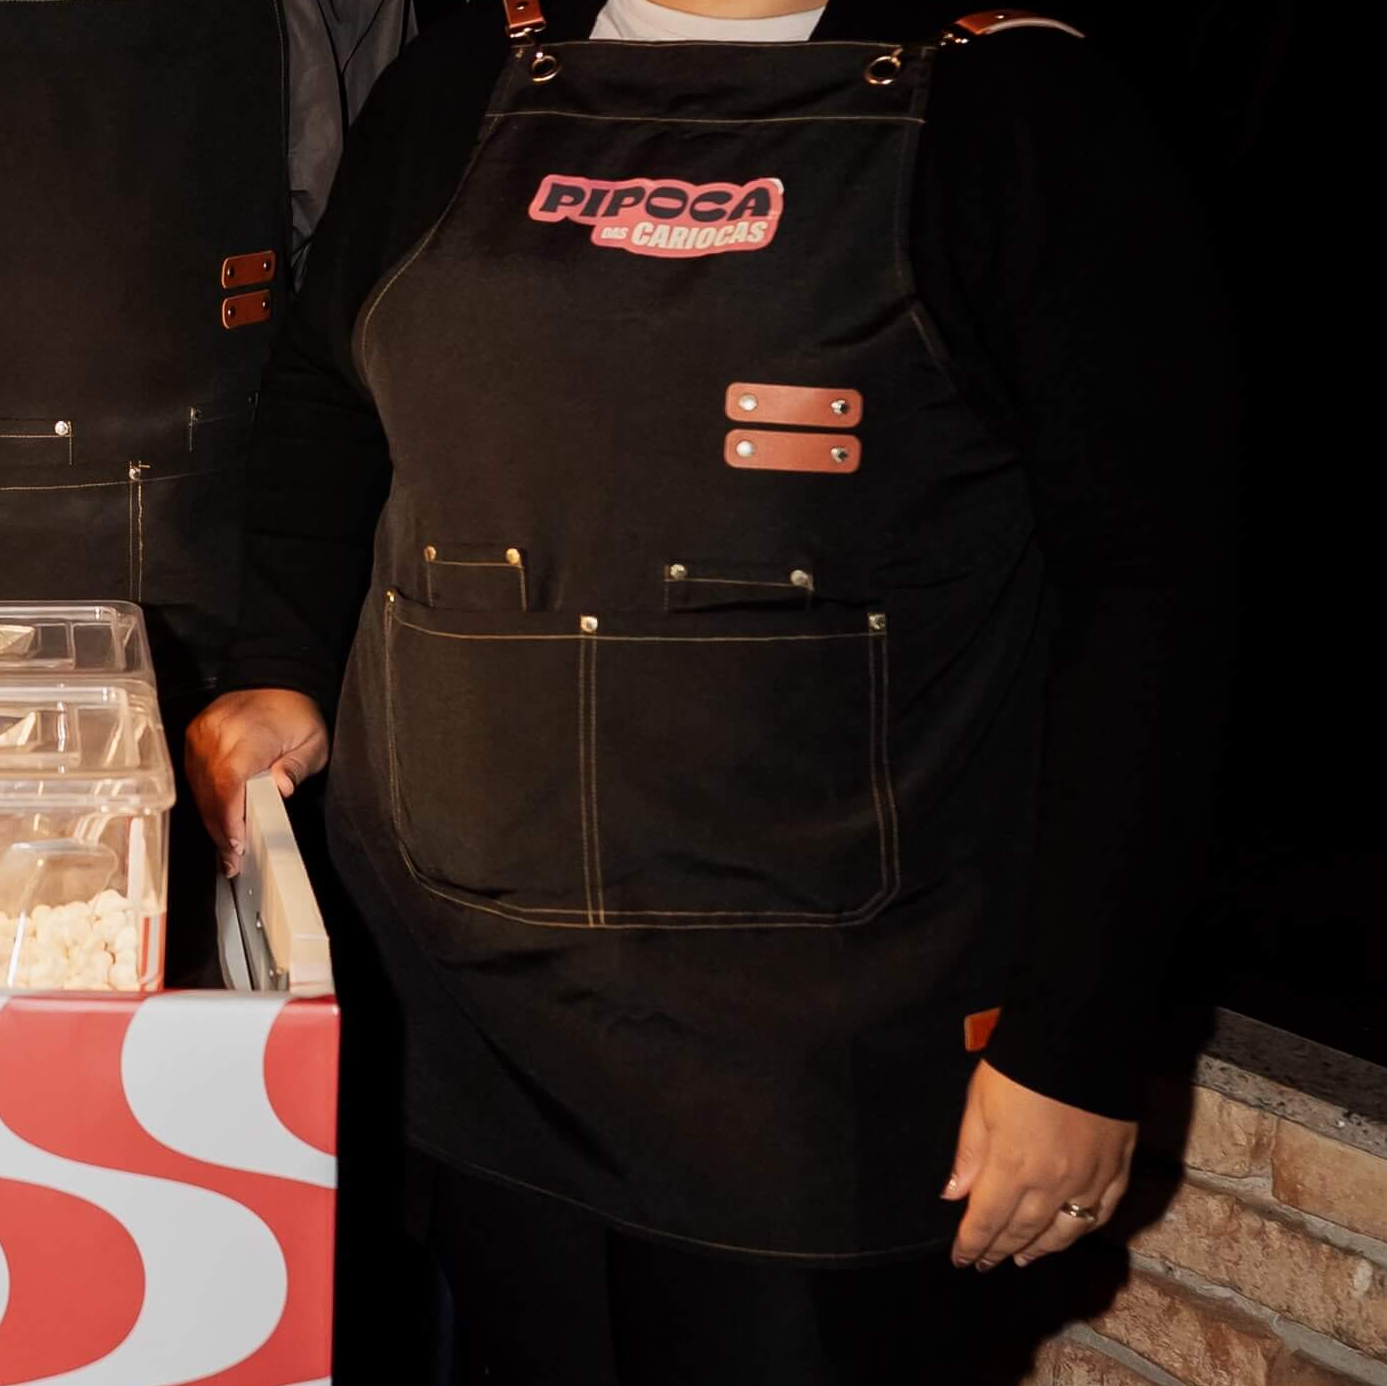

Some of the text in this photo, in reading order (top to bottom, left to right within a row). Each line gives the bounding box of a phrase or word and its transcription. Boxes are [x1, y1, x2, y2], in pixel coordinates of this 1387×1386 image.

[538, 182, 772, 223] PIPOCA
[600, 221, 769, 251] DAS CARIOCAS
